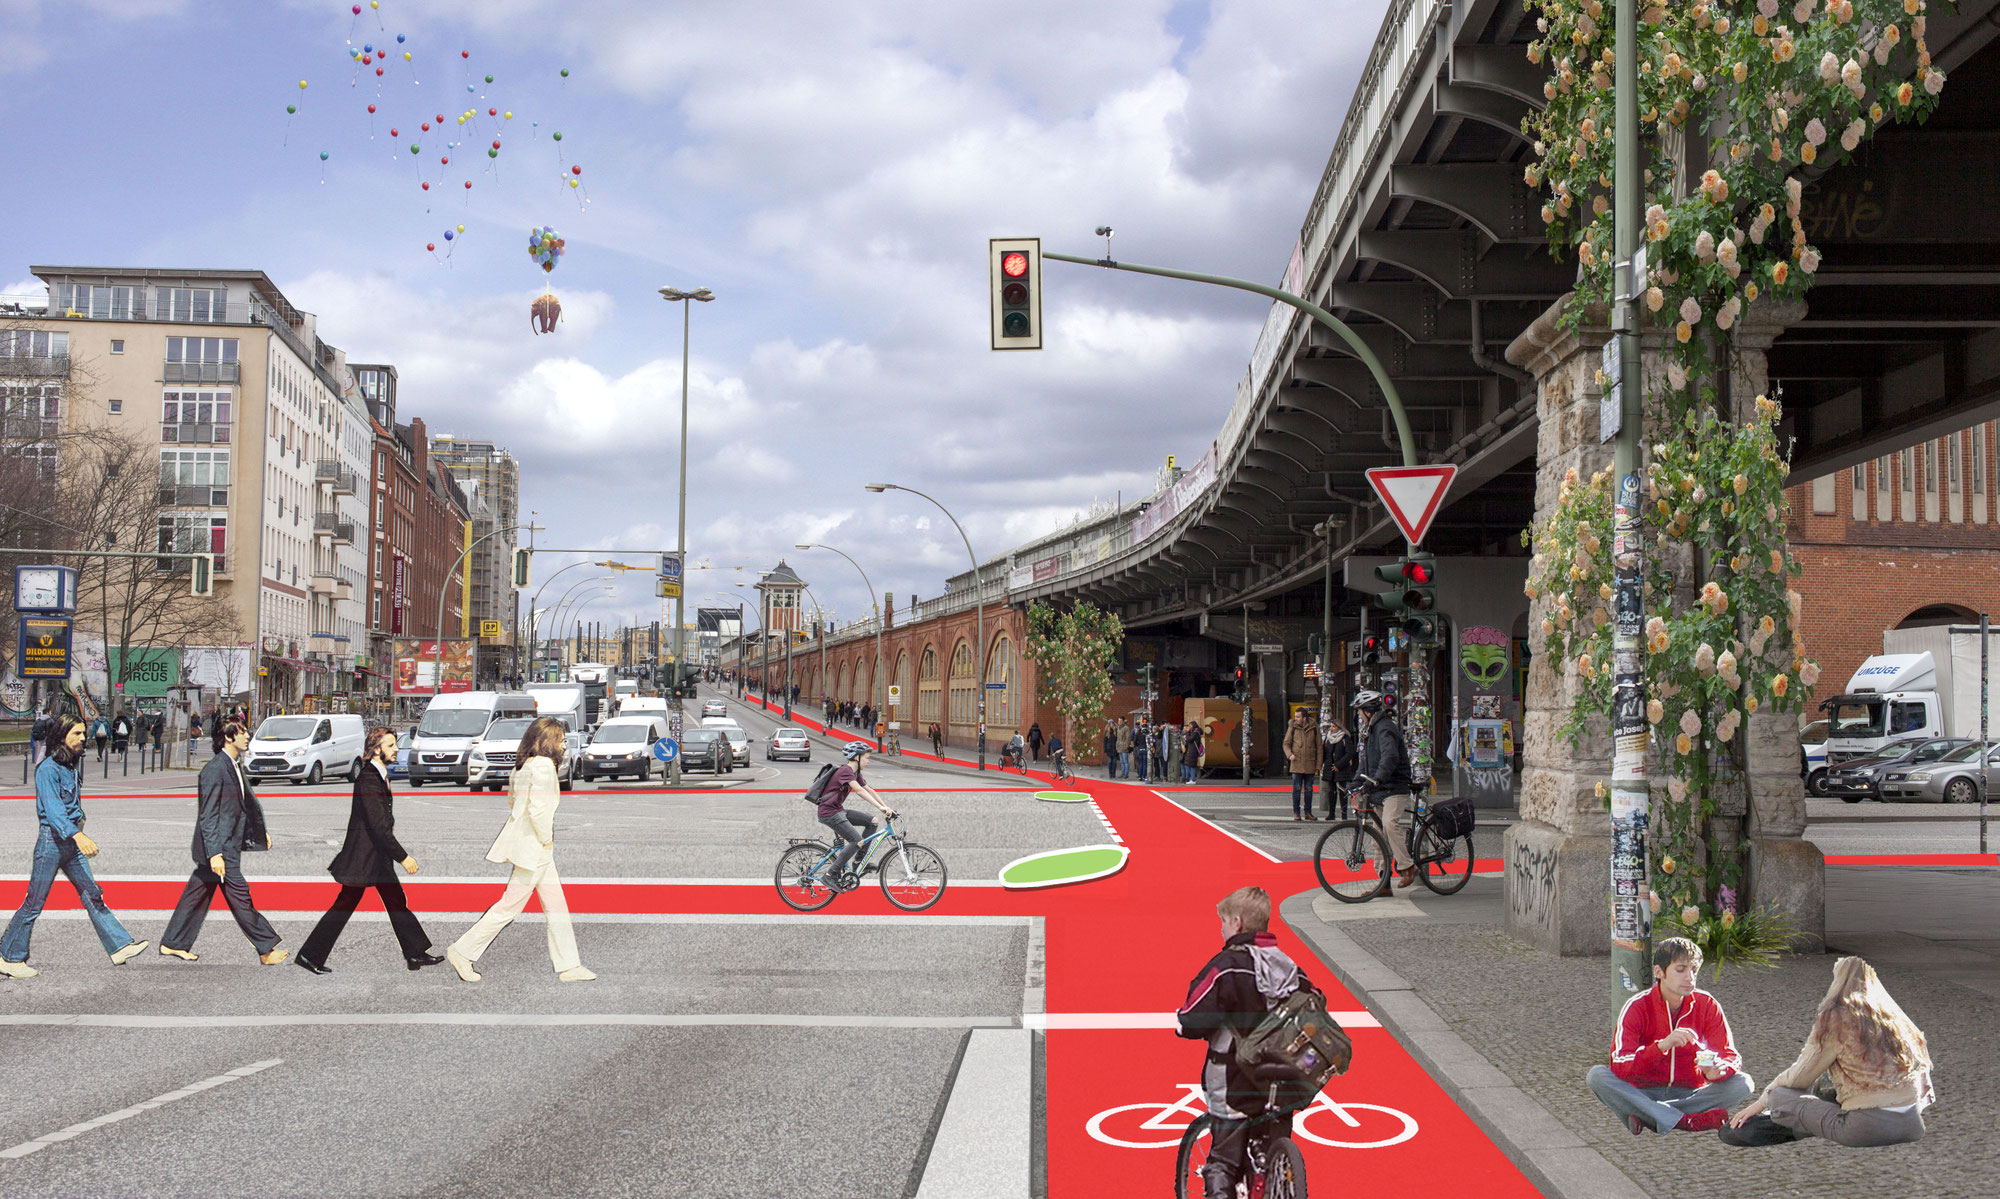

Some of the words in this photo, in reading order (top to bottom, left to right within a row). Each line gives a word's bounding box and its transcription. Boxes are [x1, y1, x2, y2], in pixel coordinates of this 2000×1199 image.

[1168, 456, 1174, 468] F
[26, 648, 66, 656] DILDOKING
[1857, 665, 1901, 676] UMZÜGE
